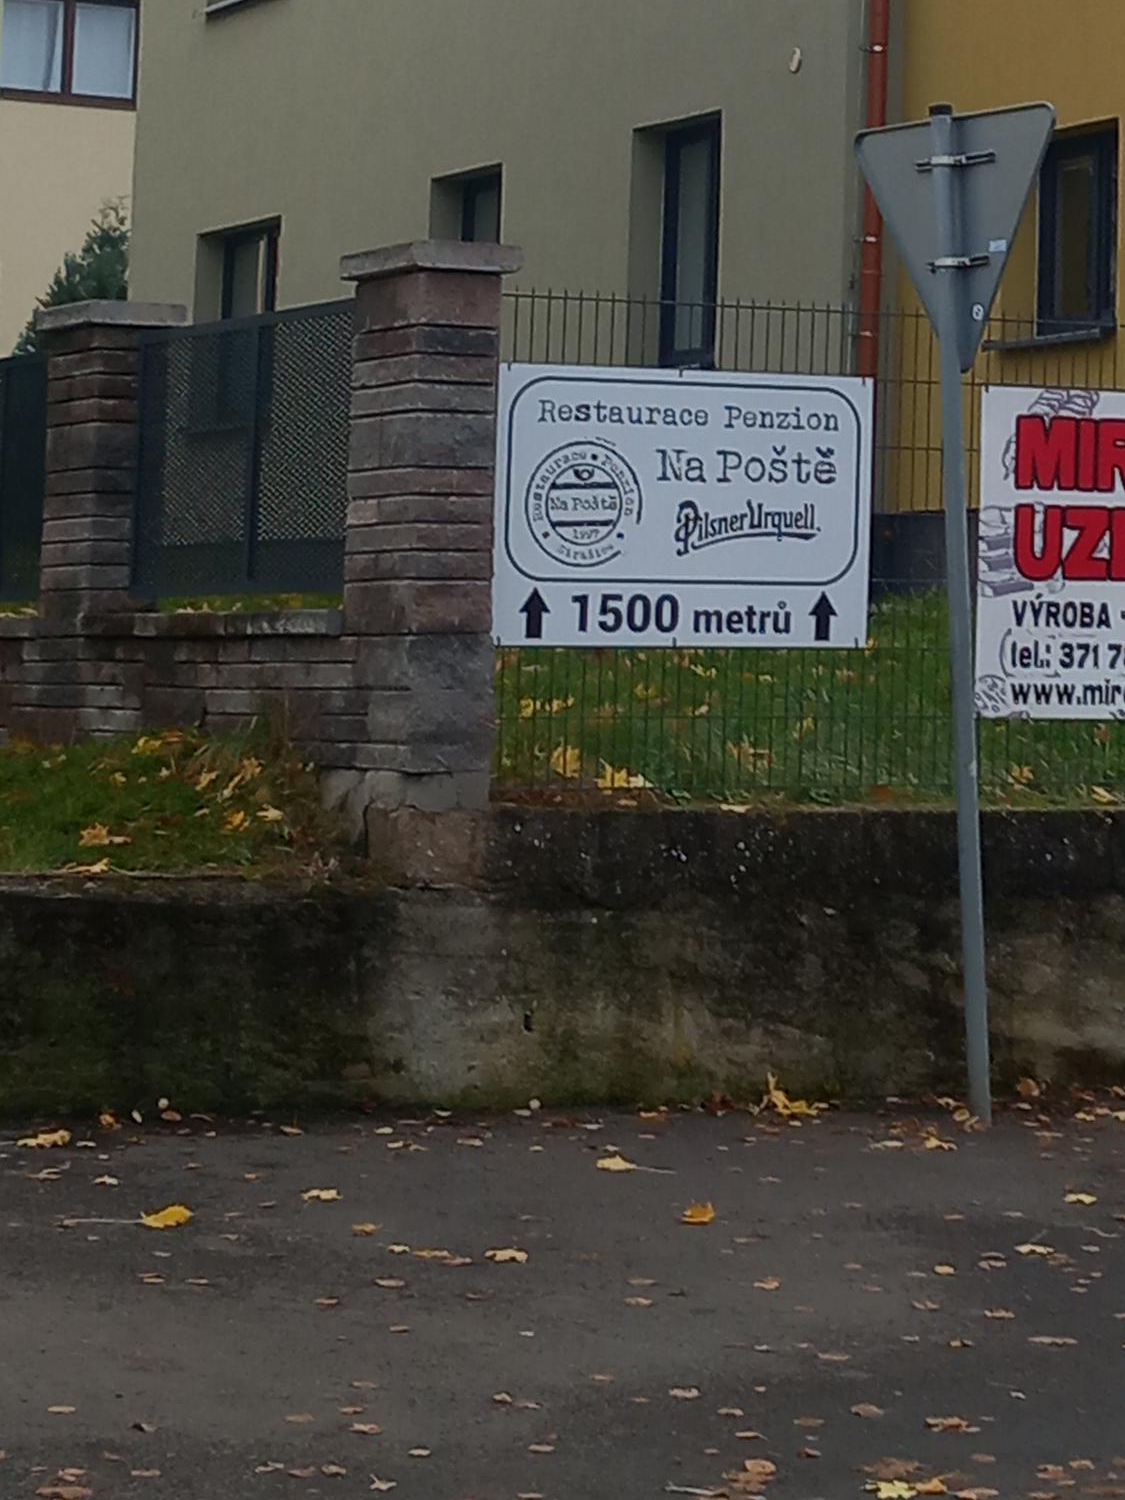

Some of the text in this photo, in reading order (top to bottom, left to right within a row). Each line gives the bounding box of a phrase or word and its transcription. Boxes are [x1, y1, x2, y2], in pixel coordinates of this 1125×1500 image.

[537, 399, 839, 431] Restaurace Penzion
[655, 445, 837, 484] Na Poště
[674, 500, 748, 556] Pilsner
[571, 594, 792, 635] 1500 metrů
[1012, 593, 1111, 630] VÝROBA
[1011, 640, 1051, 669] tel.:
[1059, 644, 1099, 669] 371
